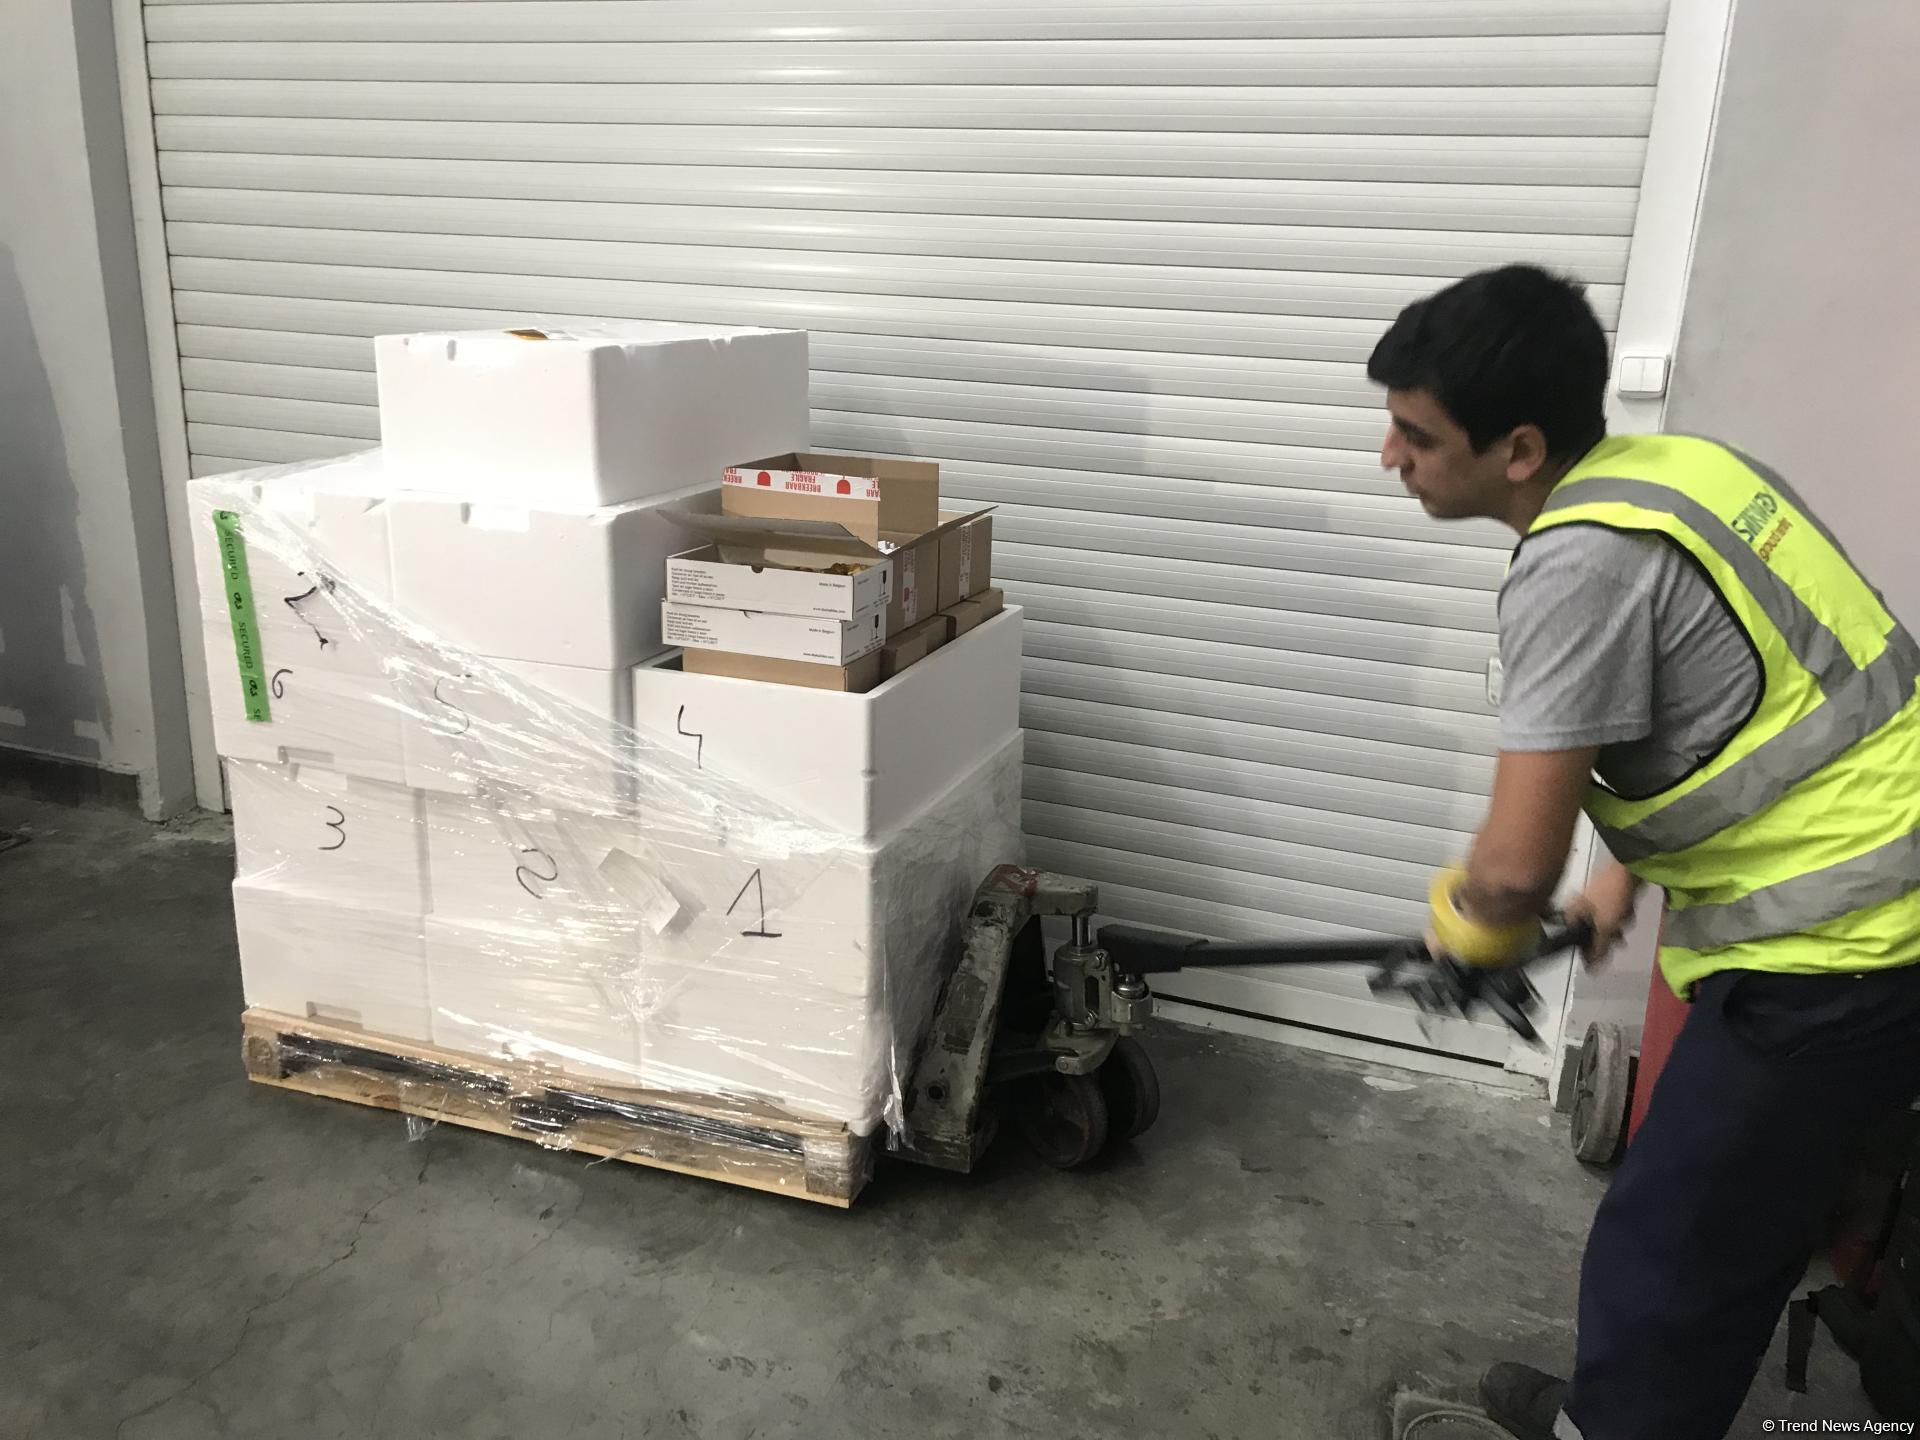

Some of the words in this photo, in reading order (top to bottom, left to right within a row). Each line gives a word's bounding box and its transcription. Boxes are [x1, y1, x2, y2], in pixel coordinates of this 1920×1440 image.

[785, 482, 821, 493] BREEKBAAR
[791, 474, 816, 484] FRAGILE
[223, 529, 240, 581] SECURED
[239, 621, 254, 670] SECURED
[271, 668, 294, 699] 6
[677, 704, 703, 769] 4
[317, 804, 346, 851] 3
[515, 848, 559, 899] 2
[726, 867, 783, 937] 1
